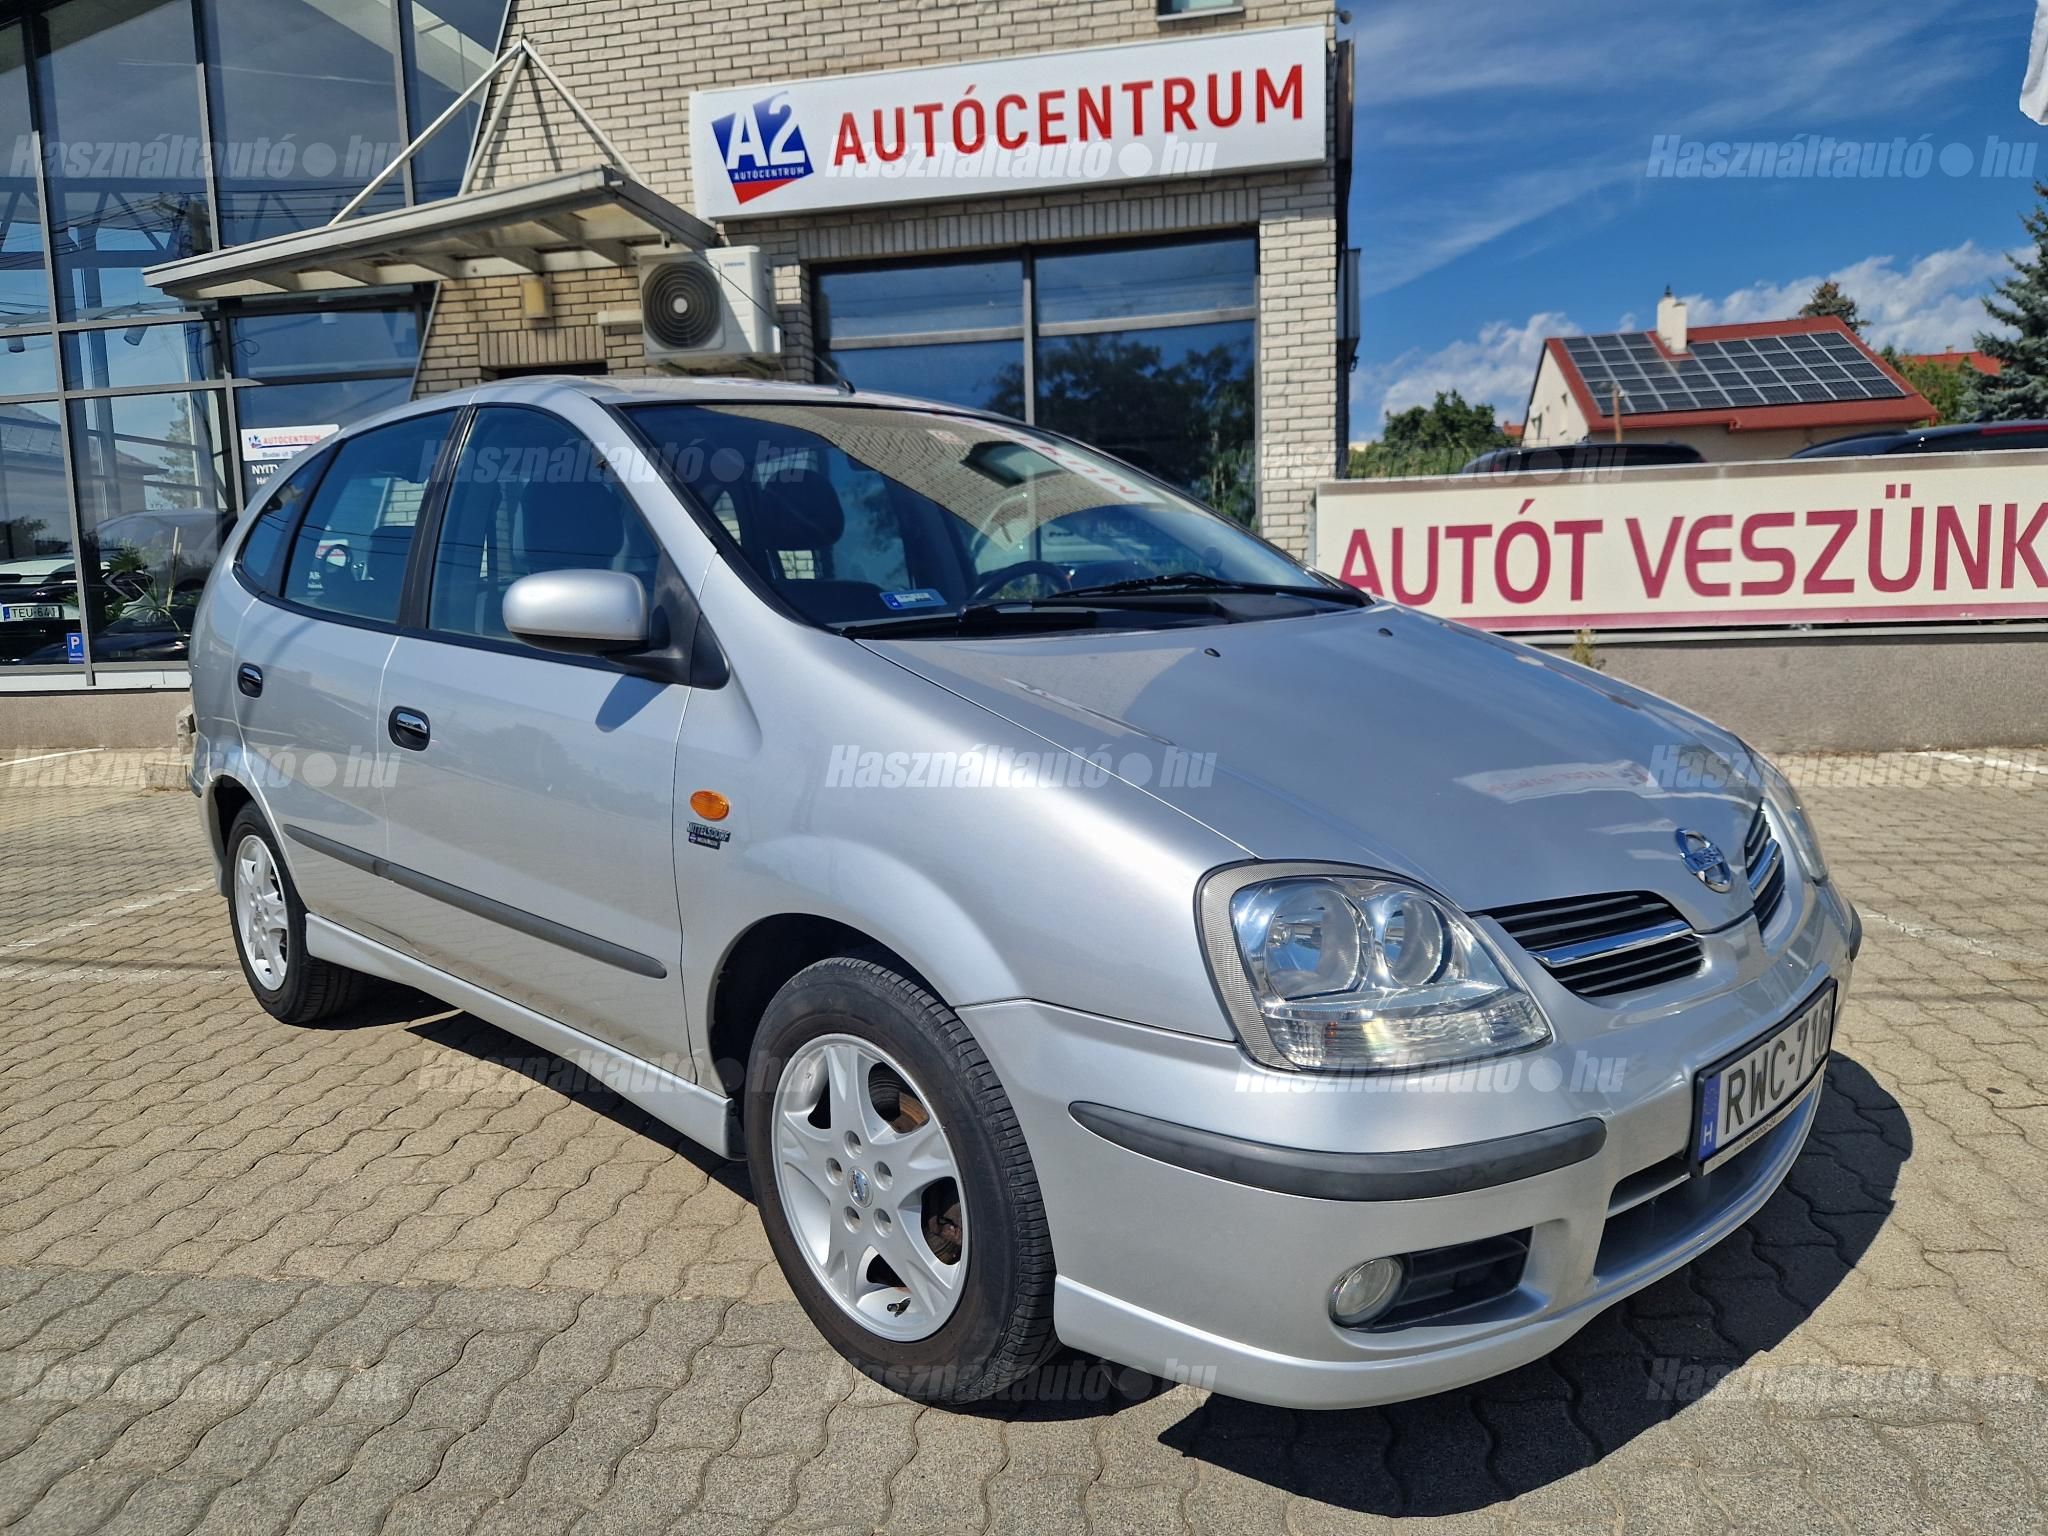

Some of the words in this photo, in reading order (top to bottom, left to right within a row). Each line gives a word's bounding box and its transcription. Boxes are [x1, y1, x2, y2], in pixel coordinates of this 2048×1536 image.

[727, 91, 805, 169] A2
[833, 64, 1303, 166] AUTÓCENTRUM
[1338, 499, 1604, 605] AUTÓT
[1625, 484, 2048, 599] VESZÜNK
[1725, 997, 1831, 1135] RWC-716
[1703, 1121, 1713, 1147] H
